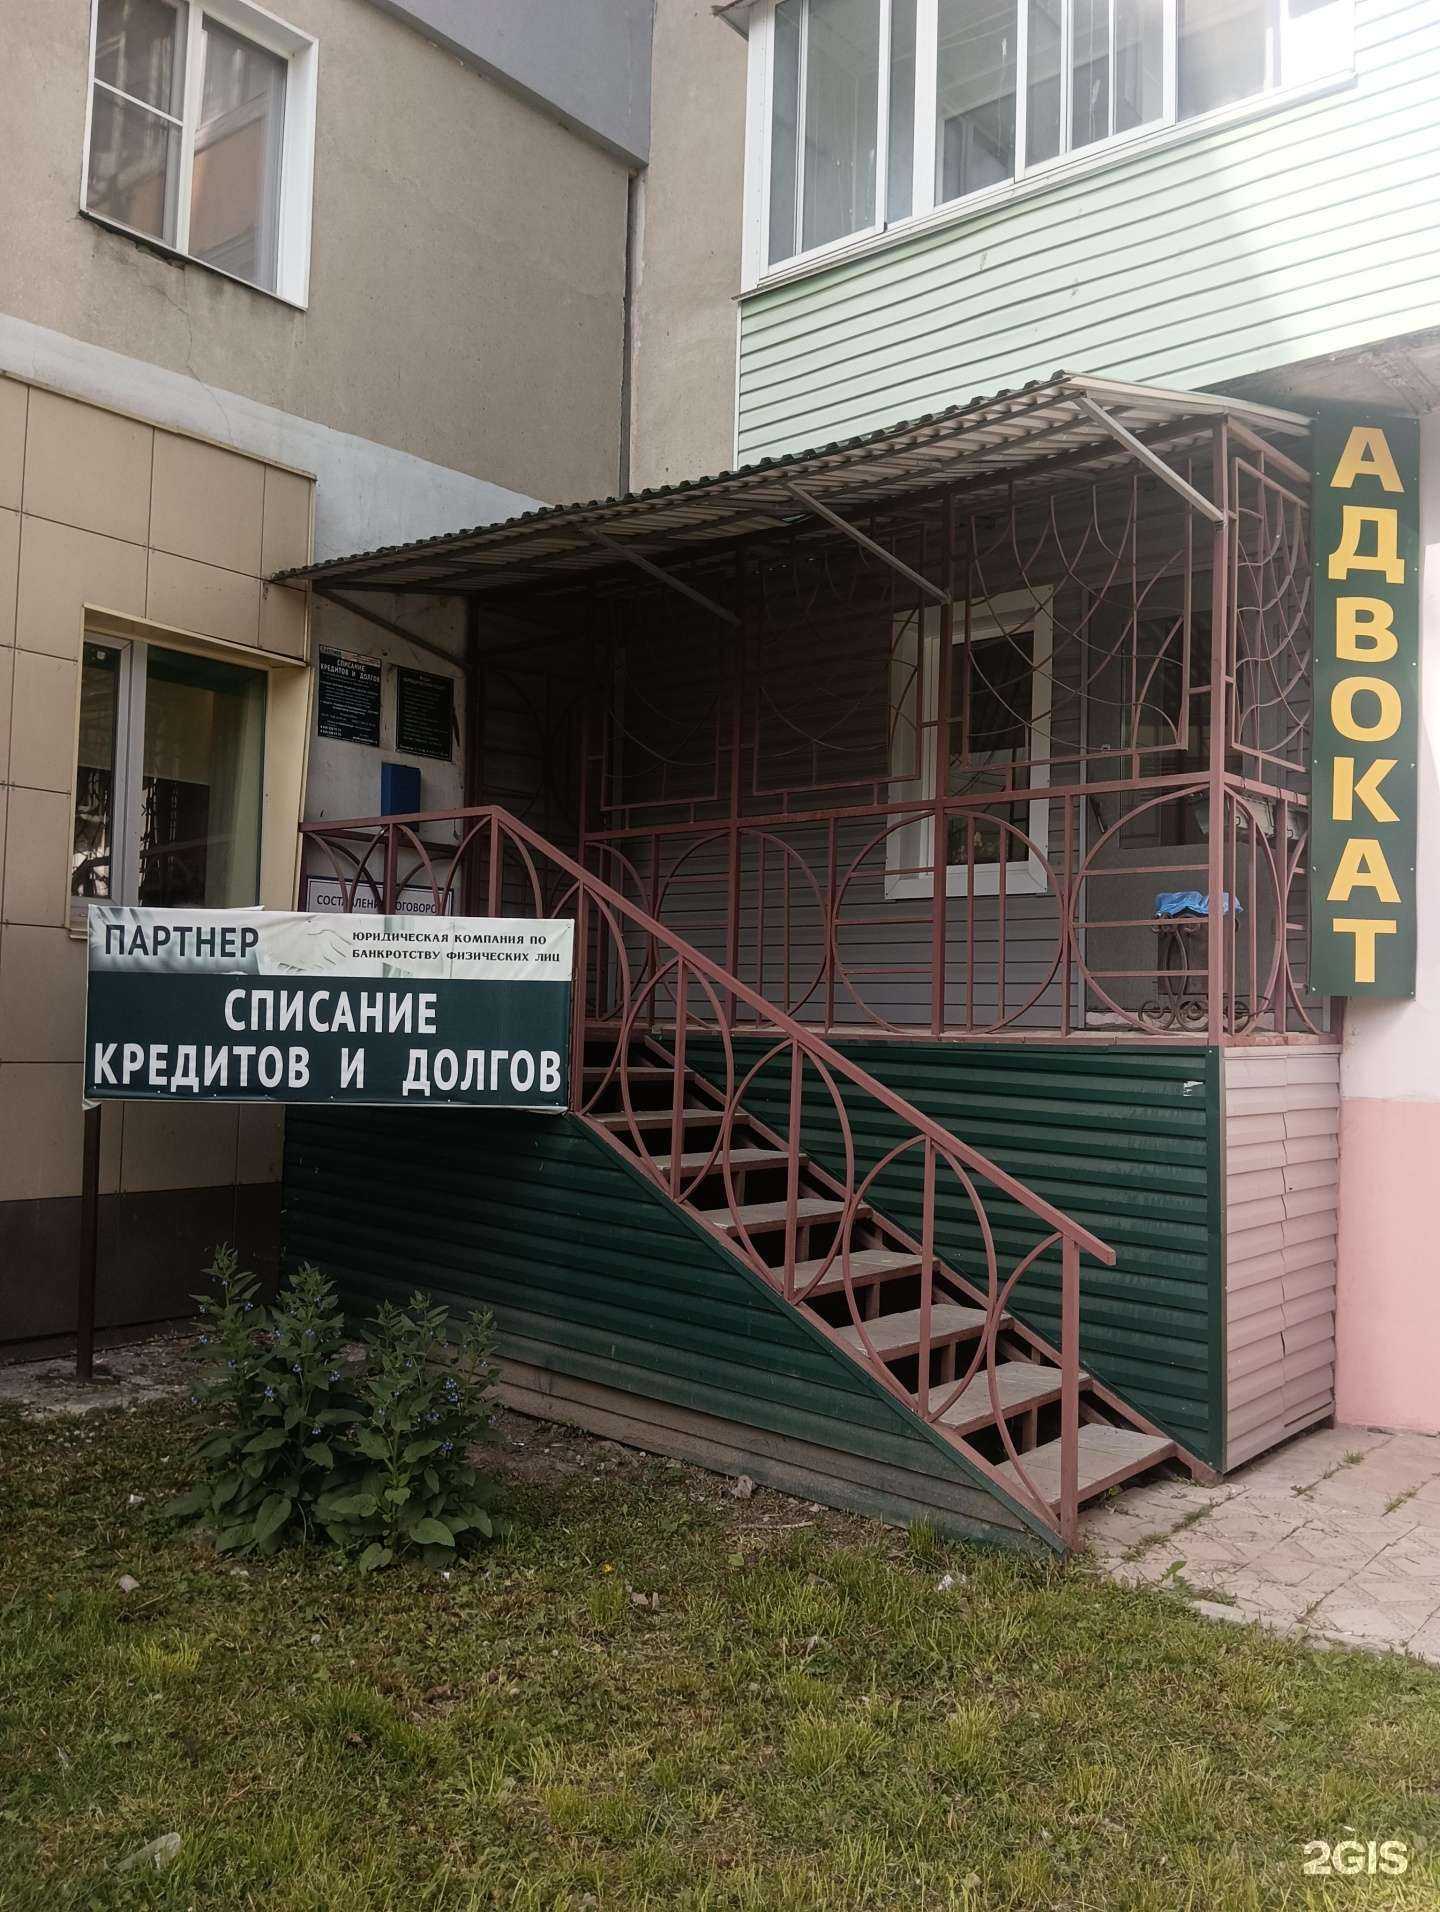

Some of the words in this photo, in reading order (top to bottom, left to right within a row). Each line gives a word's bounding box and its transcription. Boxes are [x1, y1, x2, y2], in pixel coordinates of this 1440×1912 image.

[1327, 425, 1405, 984] АДВОКАТ
[104, 924, 259, 958] ПАРТНЕР
[352, 932, 449, 943] ЮРИДИЧЕСКАЯ
[454, 934, 524, 945] КОМПАНИЯ
[530, 936, 547, 945] ПО
[352, 949, 440, 960] БАНКРОТСТВУ
[446, 951, 529, 962] ФИЗИЧЕСКИХ
[535, 953, 560, 963] ЛИЦ
[224, 988, 438, 1034] СПИСАНИЕ
[94, 1042, 310, 1093] КРЕДИТОВ
[341, 1048, 365, 1089] И
[402, 1048, 562, 1097] ДОЛГОВ
